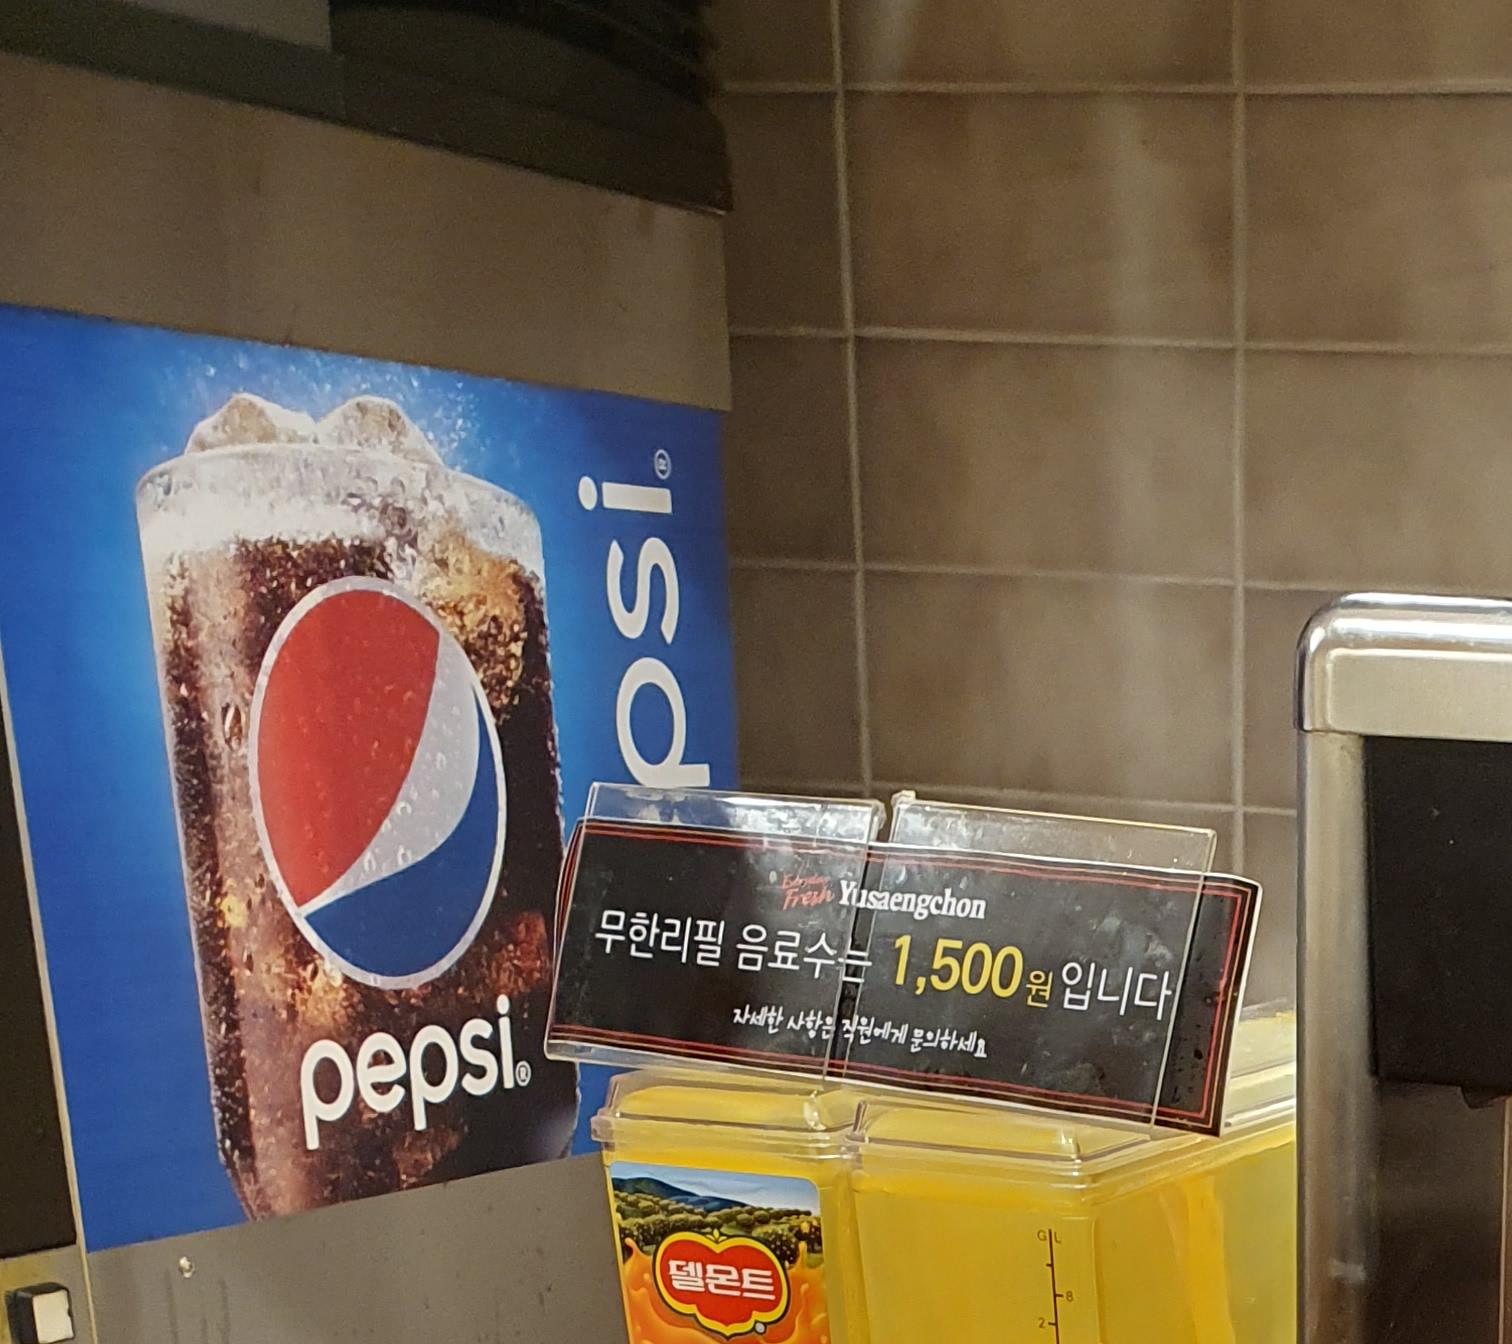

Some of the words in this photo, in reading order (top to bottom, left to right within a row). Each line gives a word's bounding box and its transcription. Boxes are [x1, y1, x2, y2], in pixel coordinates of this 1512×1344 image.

[839, 879, 987, 921] Yusaengchon
[595, 910, 726, 967] 무한리필
[736, 924, 872, 984] 음료수는
[733, 1004, 784, 1034] 자세한
[786, 1009, 836, 1039] 사항은
[841, 1012, 909, 1045] 직원에게
[910, 1028, 988, 1058] 문의하세요
[301, 994, 515, 1150] pepsi
[668, 1258, 777, 1301] 델몬트
